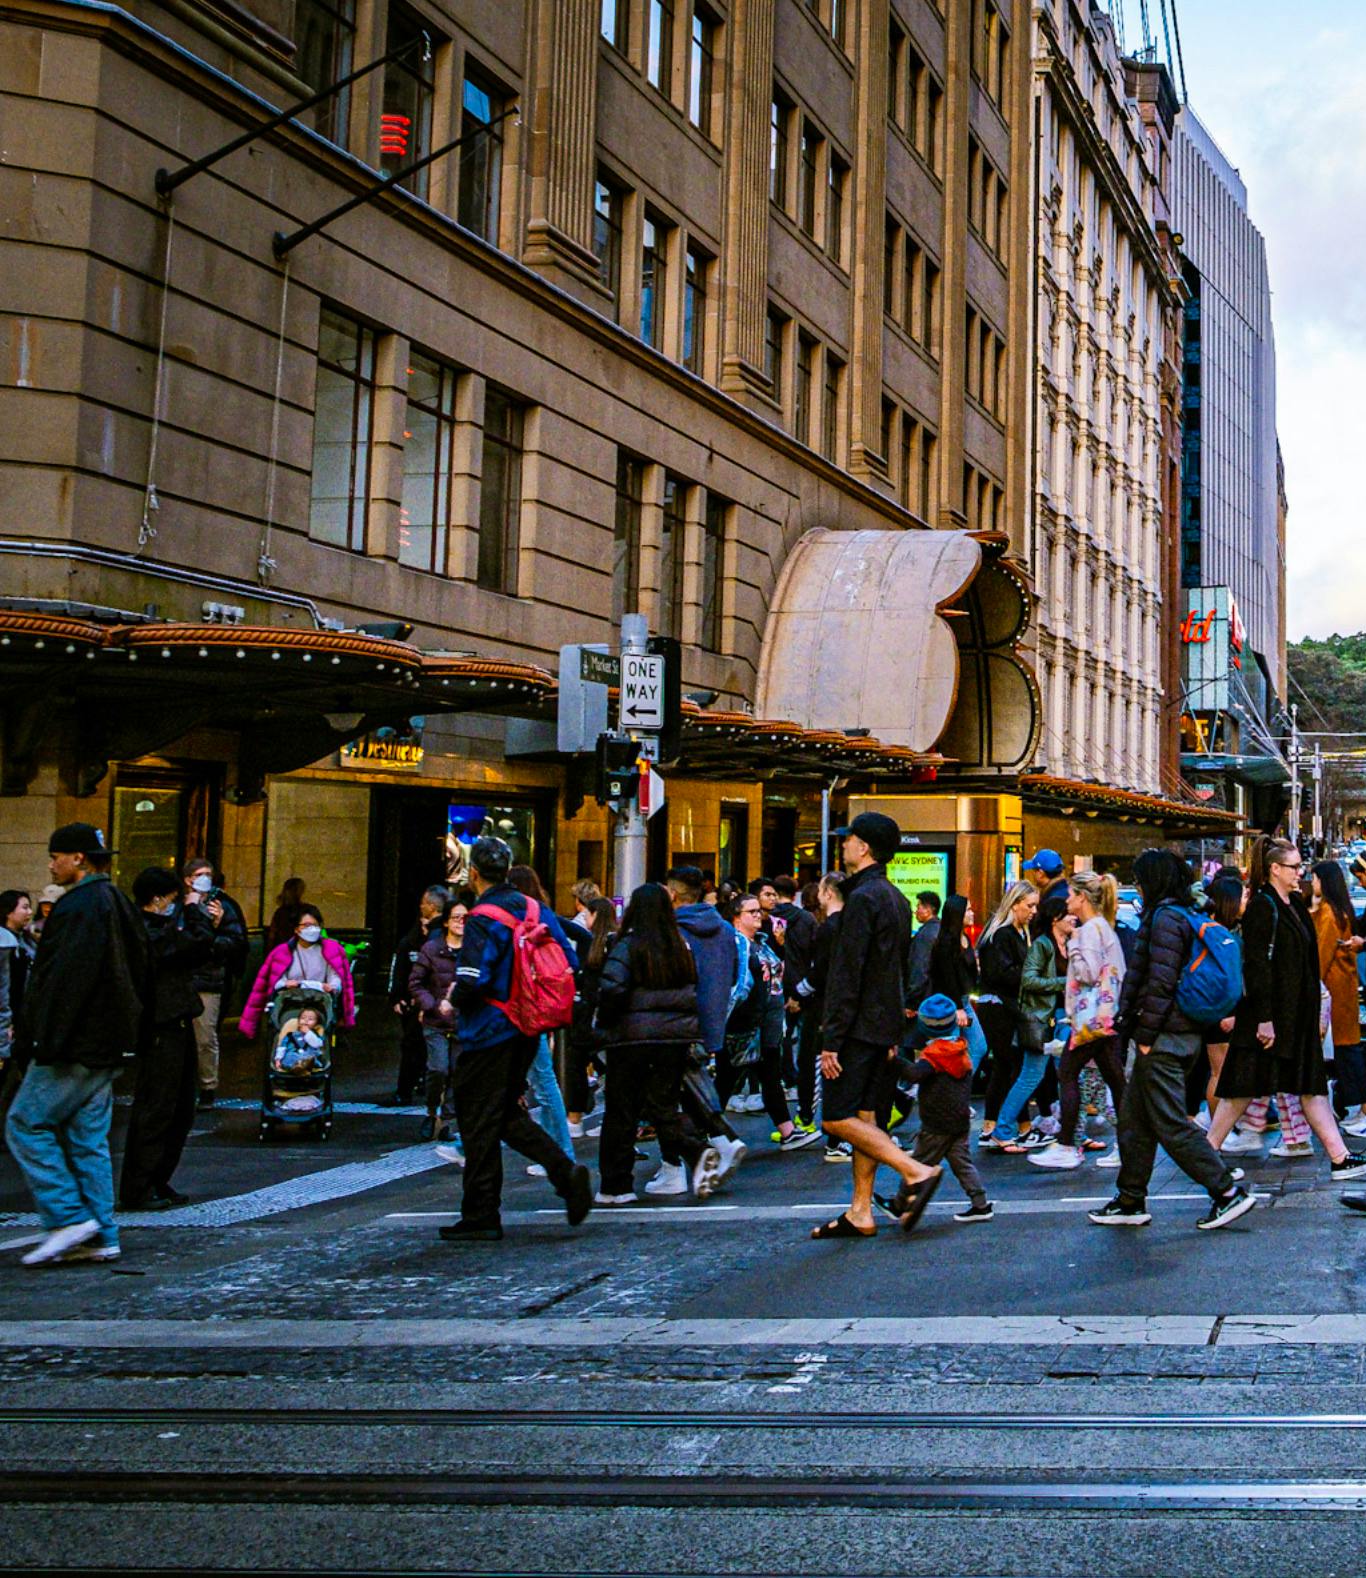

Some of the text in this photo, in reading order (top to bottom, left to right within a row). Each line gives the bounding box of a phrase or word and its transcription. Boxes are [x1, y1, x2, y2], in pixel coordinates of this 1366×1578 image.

[628, 661, 656, 678] ONE
[626, 683, 658, 700] WAY
[910, 856, 944, 865] SYDNEY
